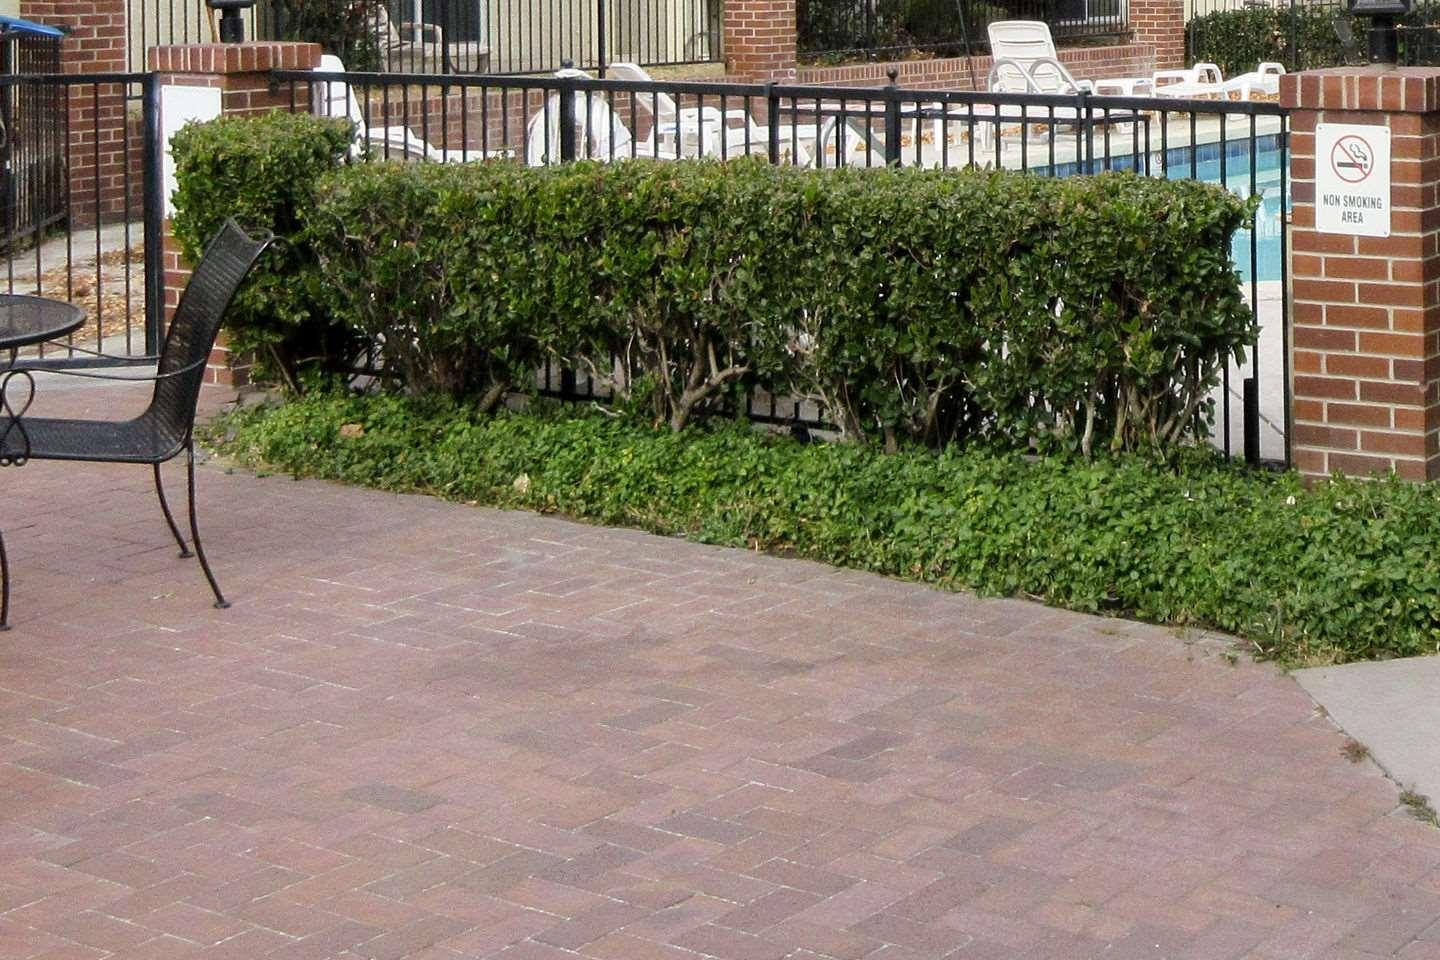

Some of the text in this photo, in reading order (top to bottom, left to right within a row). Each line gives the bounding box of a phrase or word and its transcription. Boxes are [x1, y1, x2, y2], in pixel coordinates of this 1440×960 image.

[1323, 194, 1382, 209] NON SMOKING
[1341, 211, 1364, 223] AREA
